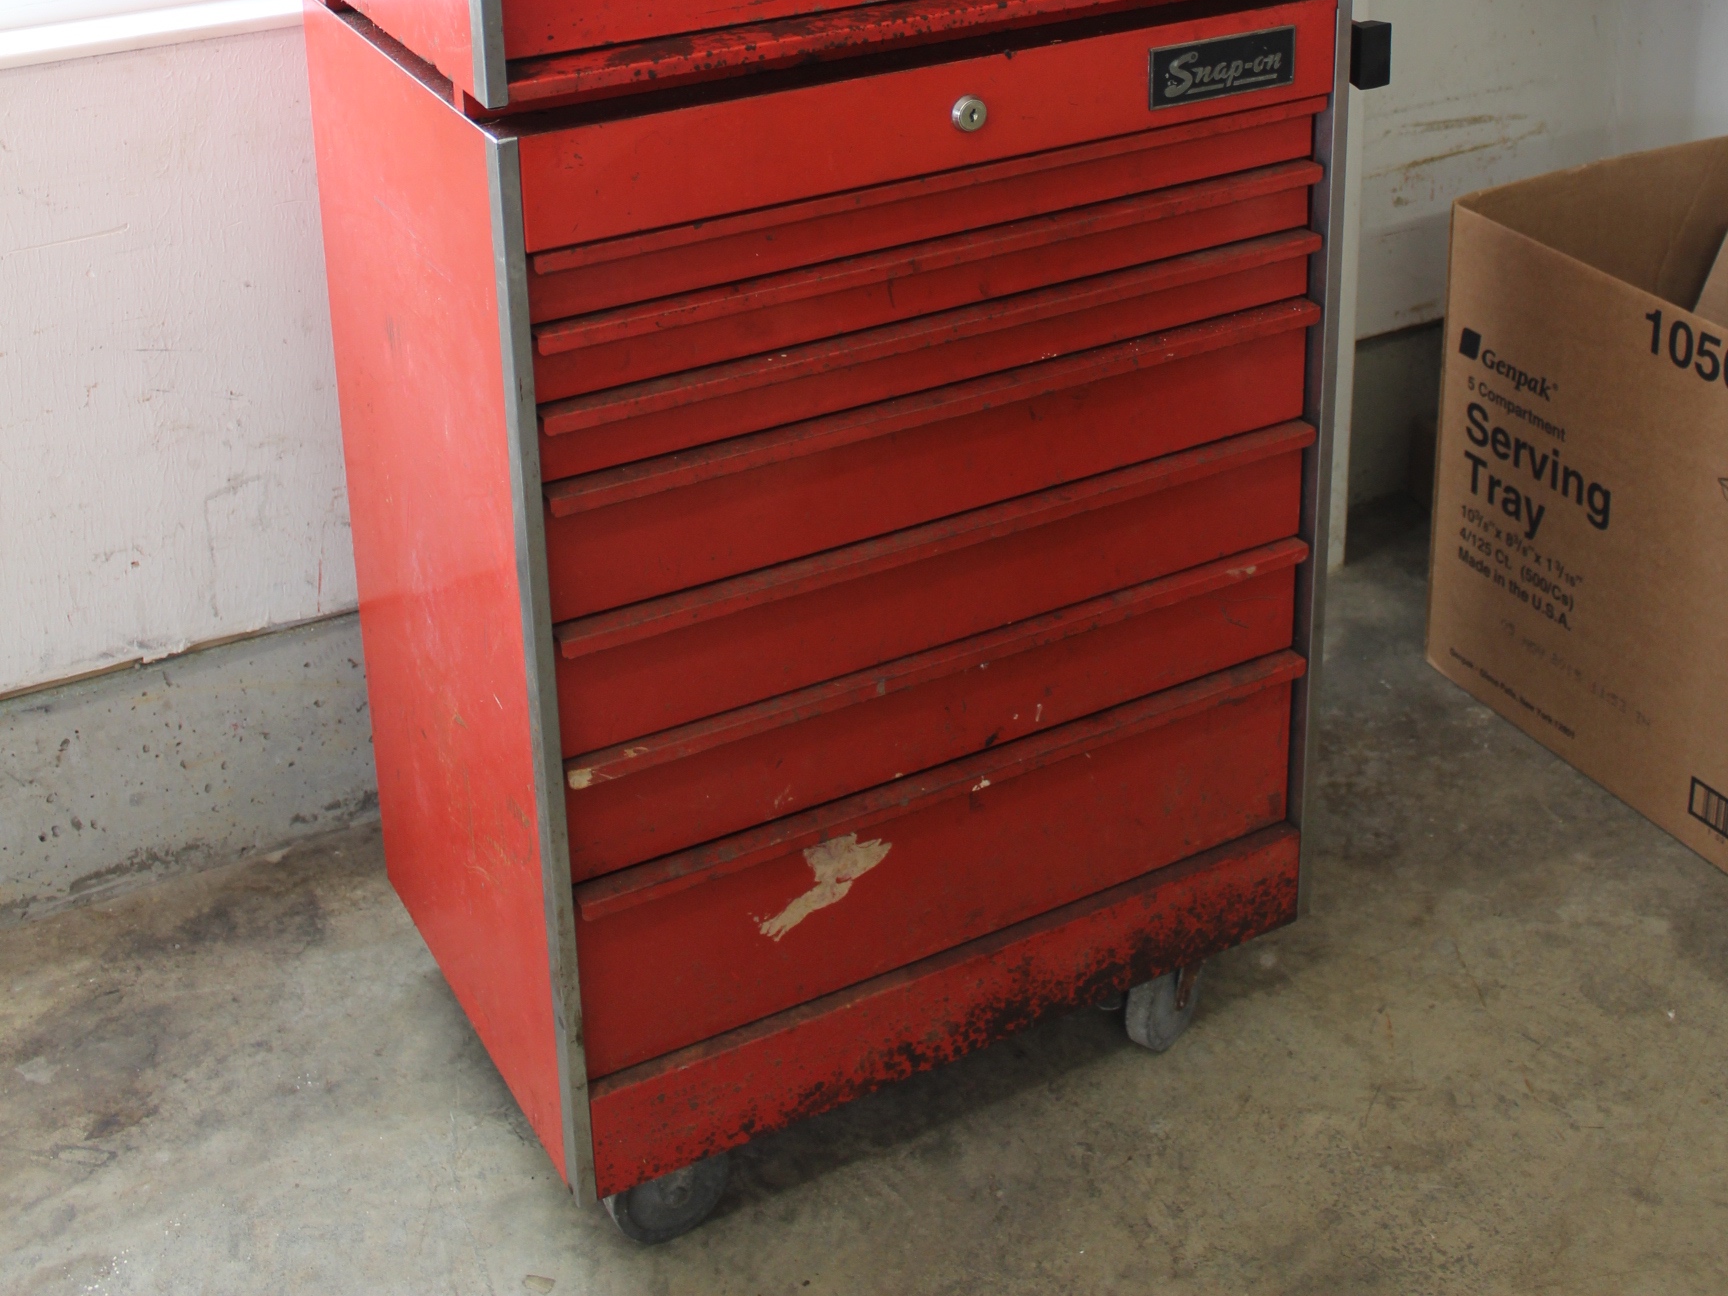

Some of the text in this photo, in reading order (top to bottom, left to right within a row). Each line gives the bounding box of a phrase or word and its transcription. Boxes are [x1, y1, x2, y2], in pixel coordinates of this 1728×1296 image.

[1164, 51, 1282, 98] Snap-on
[1646, 308, 1728, 390] 105
[1467, 376, 1566, 442] 5 Compartment
[1464, 450, 1546, 540] Tray
[1466, 402, 1611, 531] Serving
[1458, 546, 1491, 579] Made
[1493, 568, 1506, 588] in
[1508, 580, 1529, 603] the
[1532, 593, 1571, 632] U.S.A.
[1459, 527, 1575, 613] 4/125 Ct. (500/Cs)
